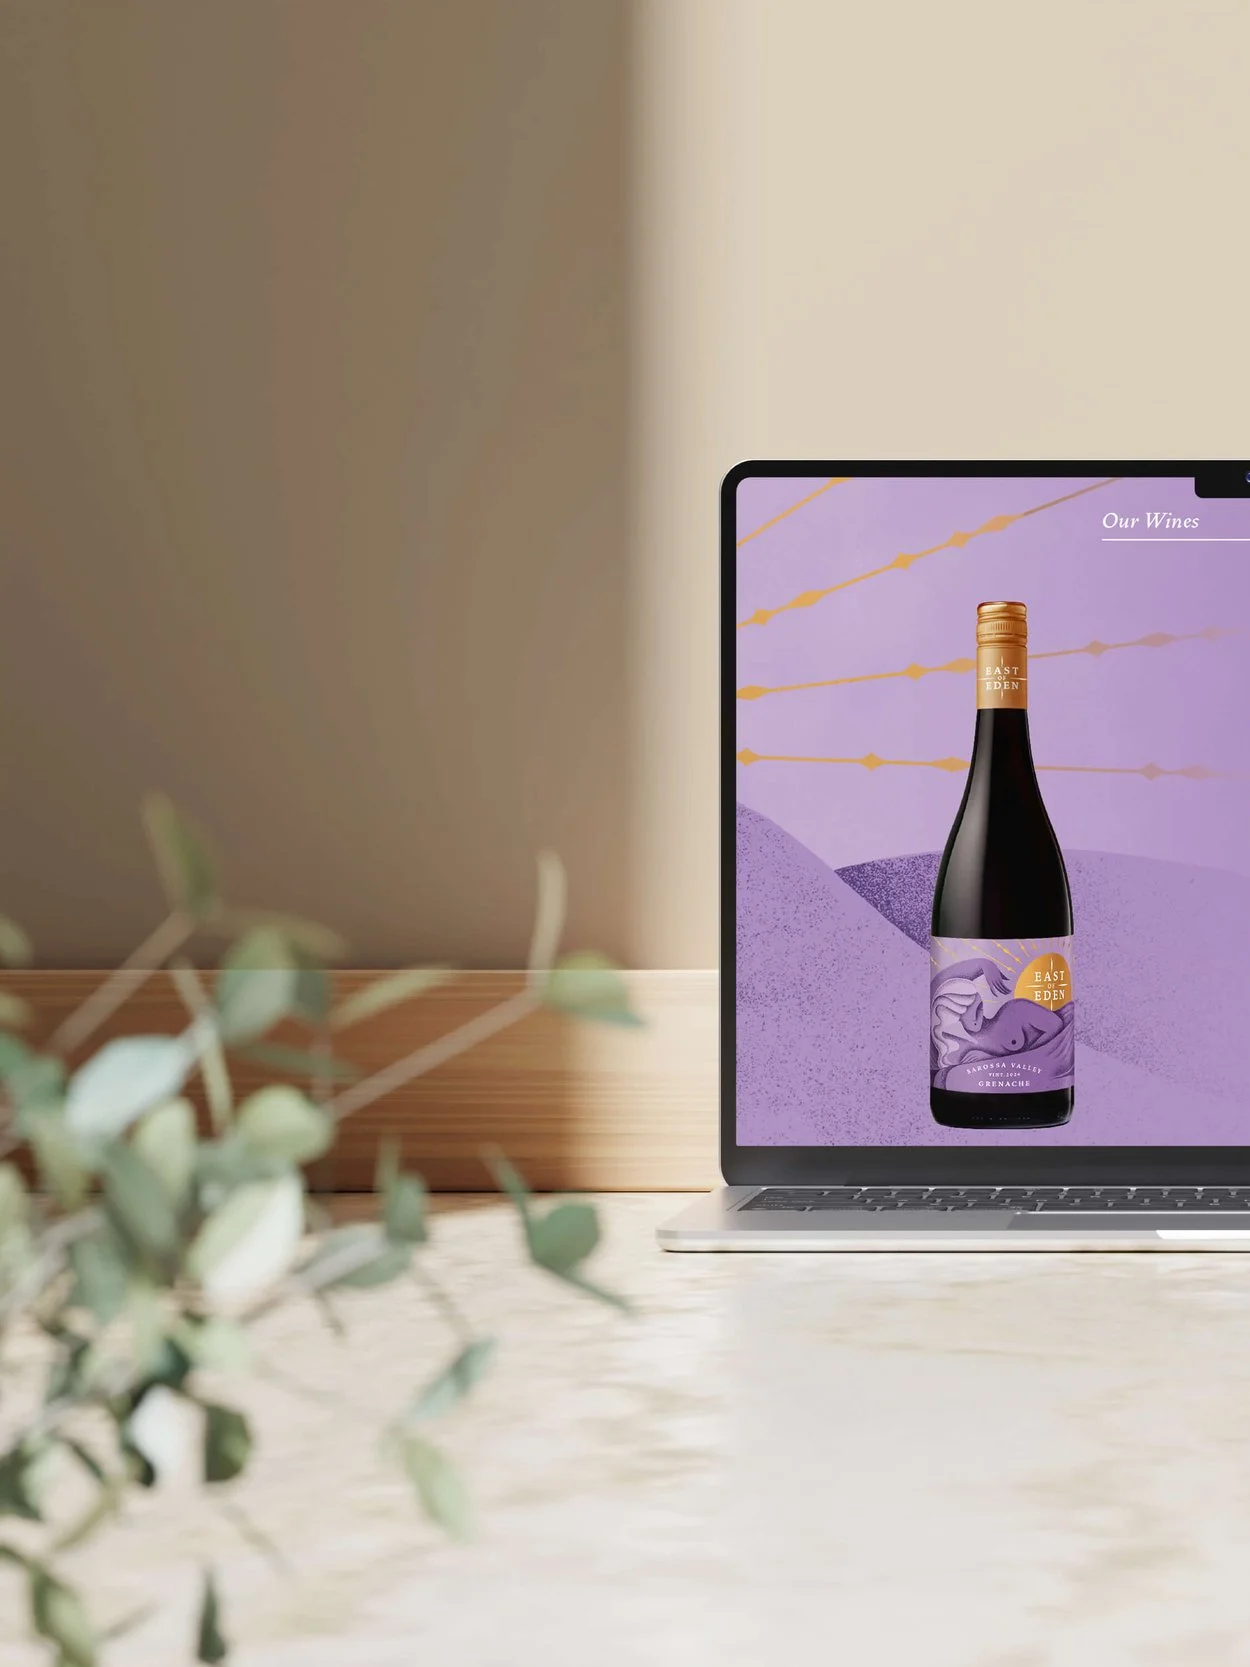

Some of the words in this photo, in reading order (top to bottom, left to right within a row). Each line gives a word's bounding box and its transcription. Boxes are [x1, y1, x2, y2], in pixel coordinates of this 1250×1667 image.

[1102, 512, 1140, 529] Our
[1145, 512, 1200, 529] Wines
[985, 666, 1018, 675] EAST
[985, 681, 1019, 690] EDEN
[1034, 971, 1065, 982] EAST
[1034, 989, 1065, 1001] EDEN
[1010, 1062, 1042, 1074] VALLEY
[978, 1080, 1031, 1088] GRENACHE
